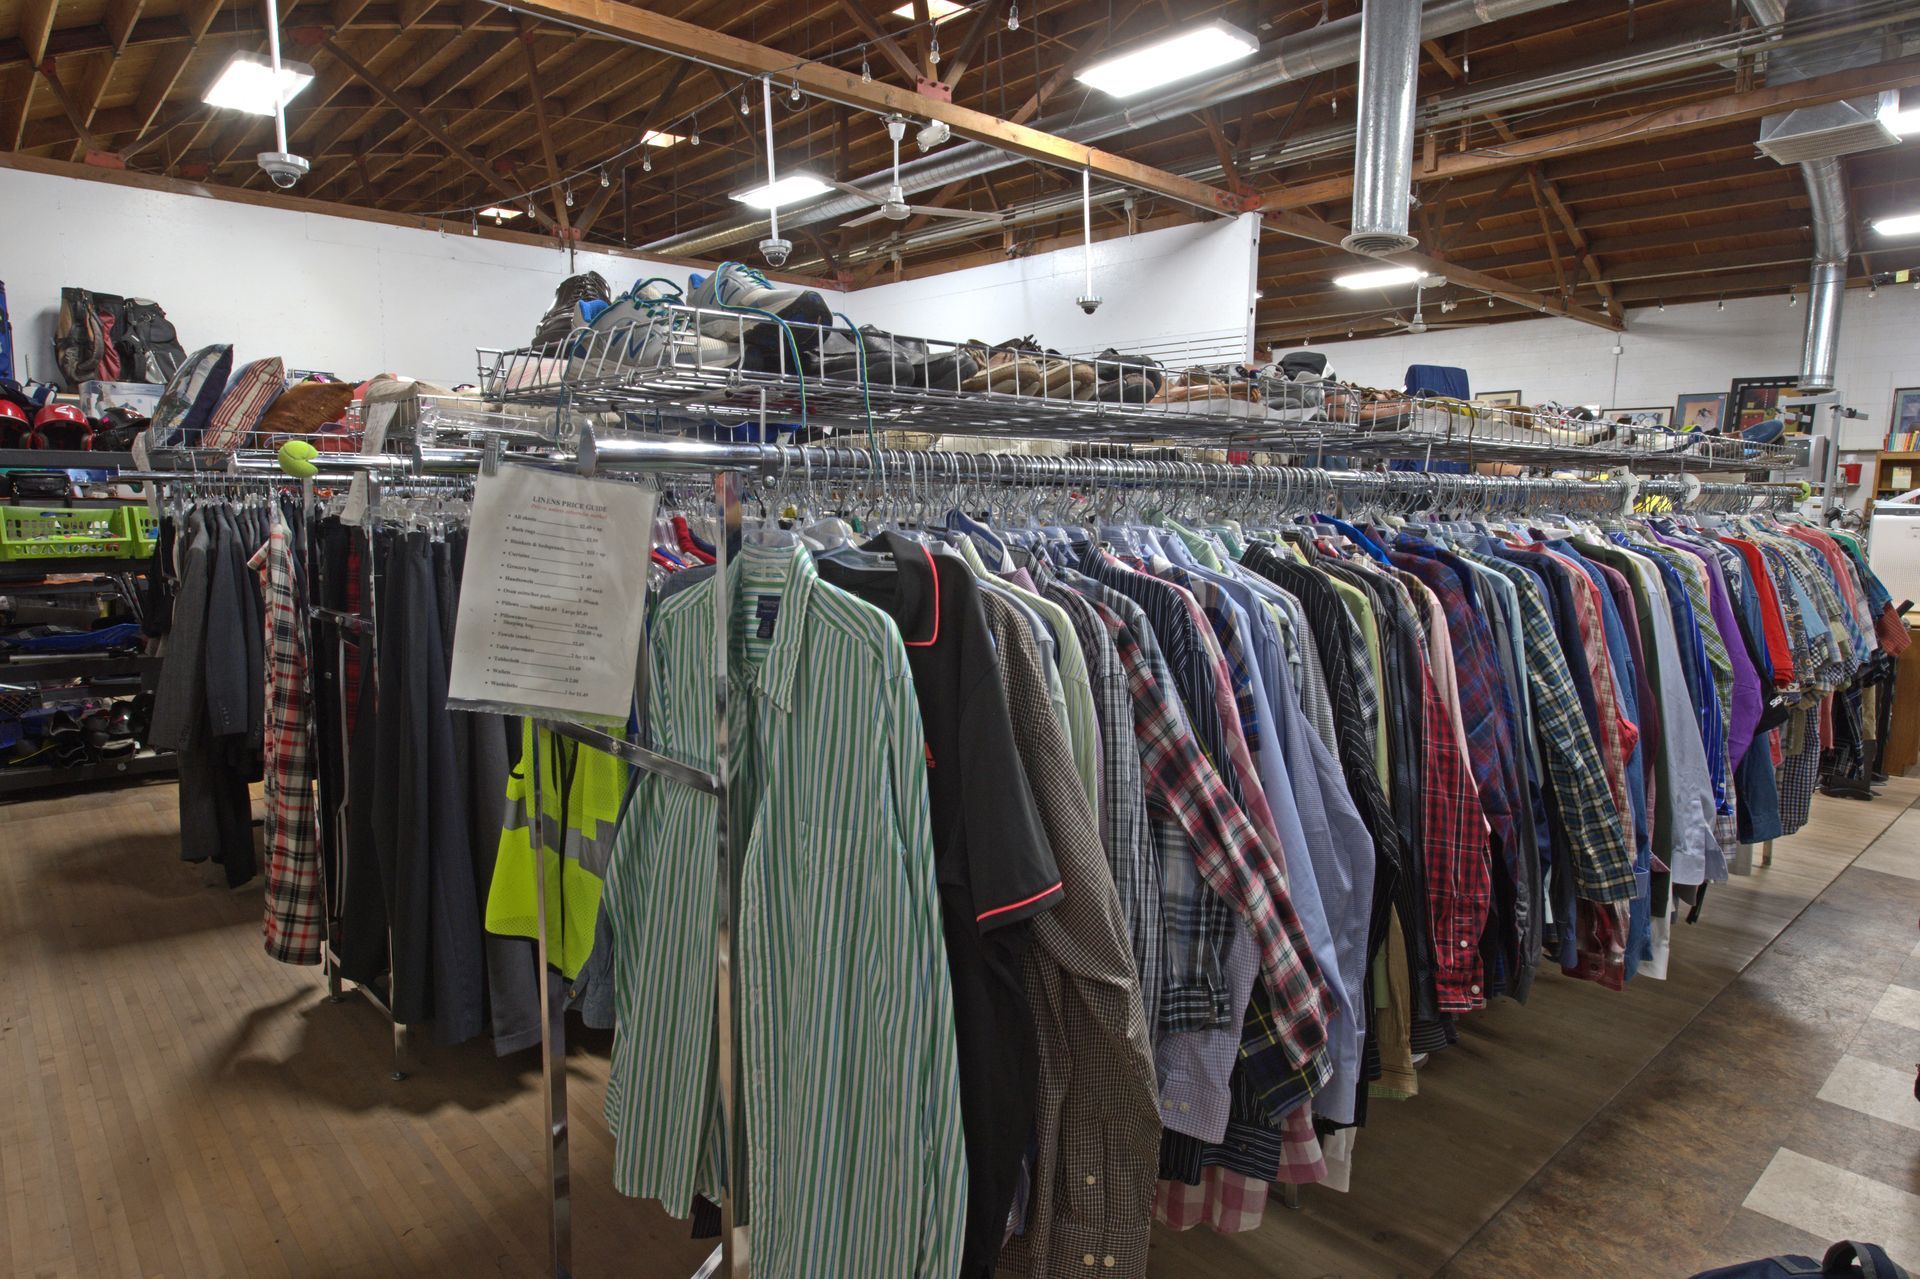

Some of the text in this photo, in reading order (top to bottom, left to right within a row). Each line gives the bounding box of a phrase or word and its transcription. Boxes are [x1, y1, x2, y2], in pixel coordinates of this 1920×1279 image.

[1612, 468, 1624, 478] XL
[533, 496, 560, 506] LINENS
[561, 500, 585, 510] PRICE
[585, 503, 607, 512] GUIDE
